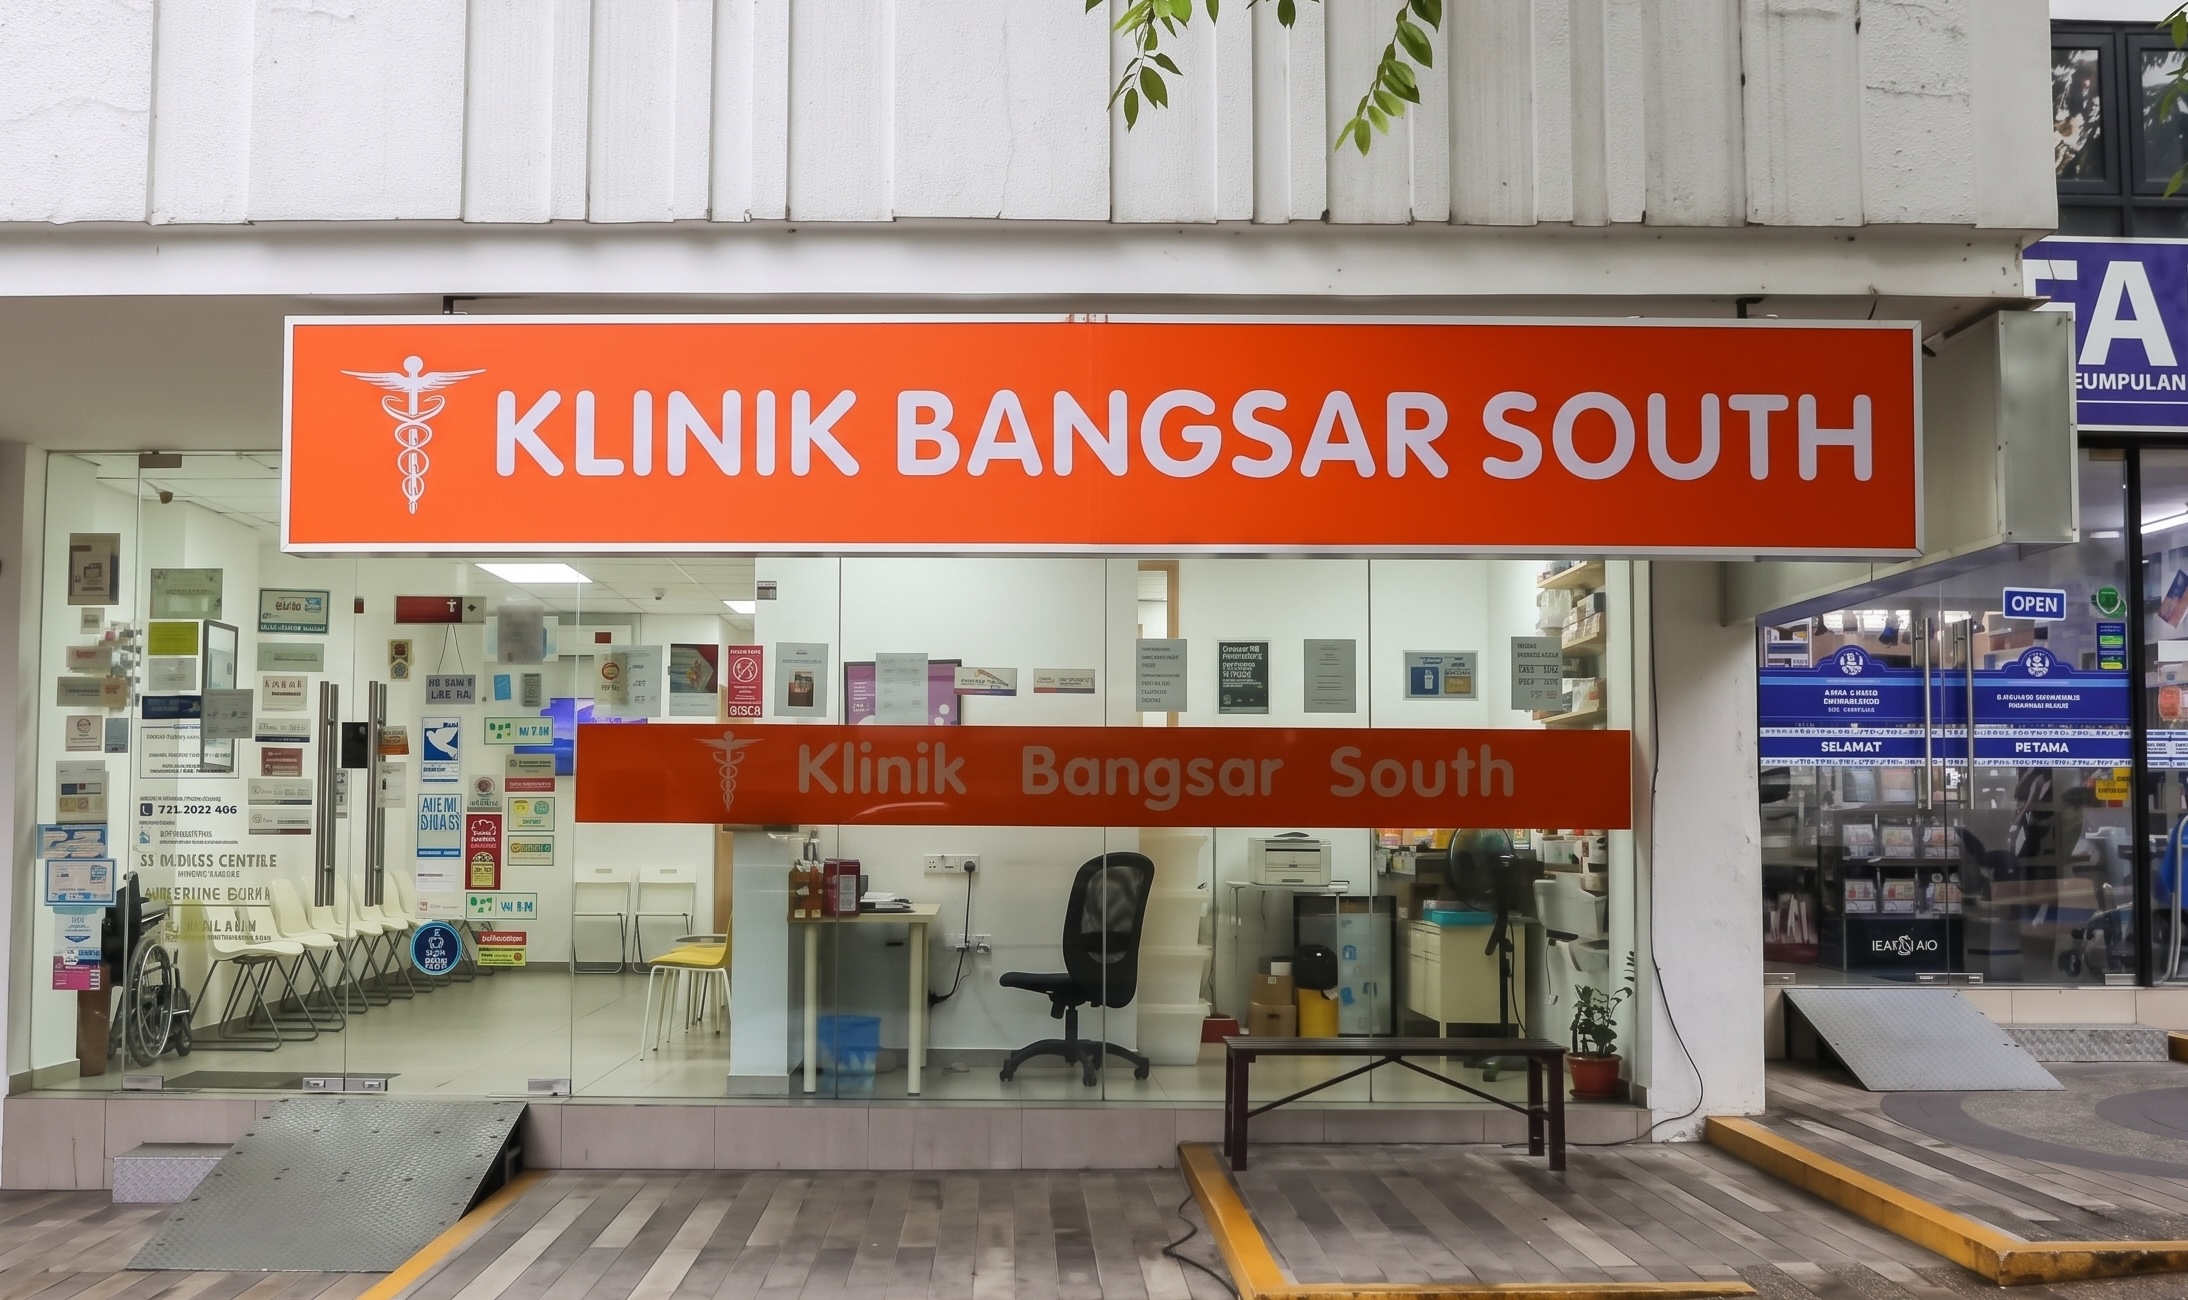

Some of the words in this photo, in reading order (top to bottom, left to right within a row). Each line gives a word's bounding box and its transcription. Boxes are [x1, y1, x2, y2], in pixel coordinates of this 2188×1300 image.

[496, 389, 860, 477] KLINIK
[897, 389, 1449, 480] BANGSAR
[1482, 391, 1872, 481] SOUTH
[2011, 595, 2058, 613] OPEN
[1821, 741, 1882, 752] SELAMAT
[799, 741, 967, 795] Klinik
[1022, 745, 1284, 812] Bangsar
[1330, 743, 1514, 798] South
